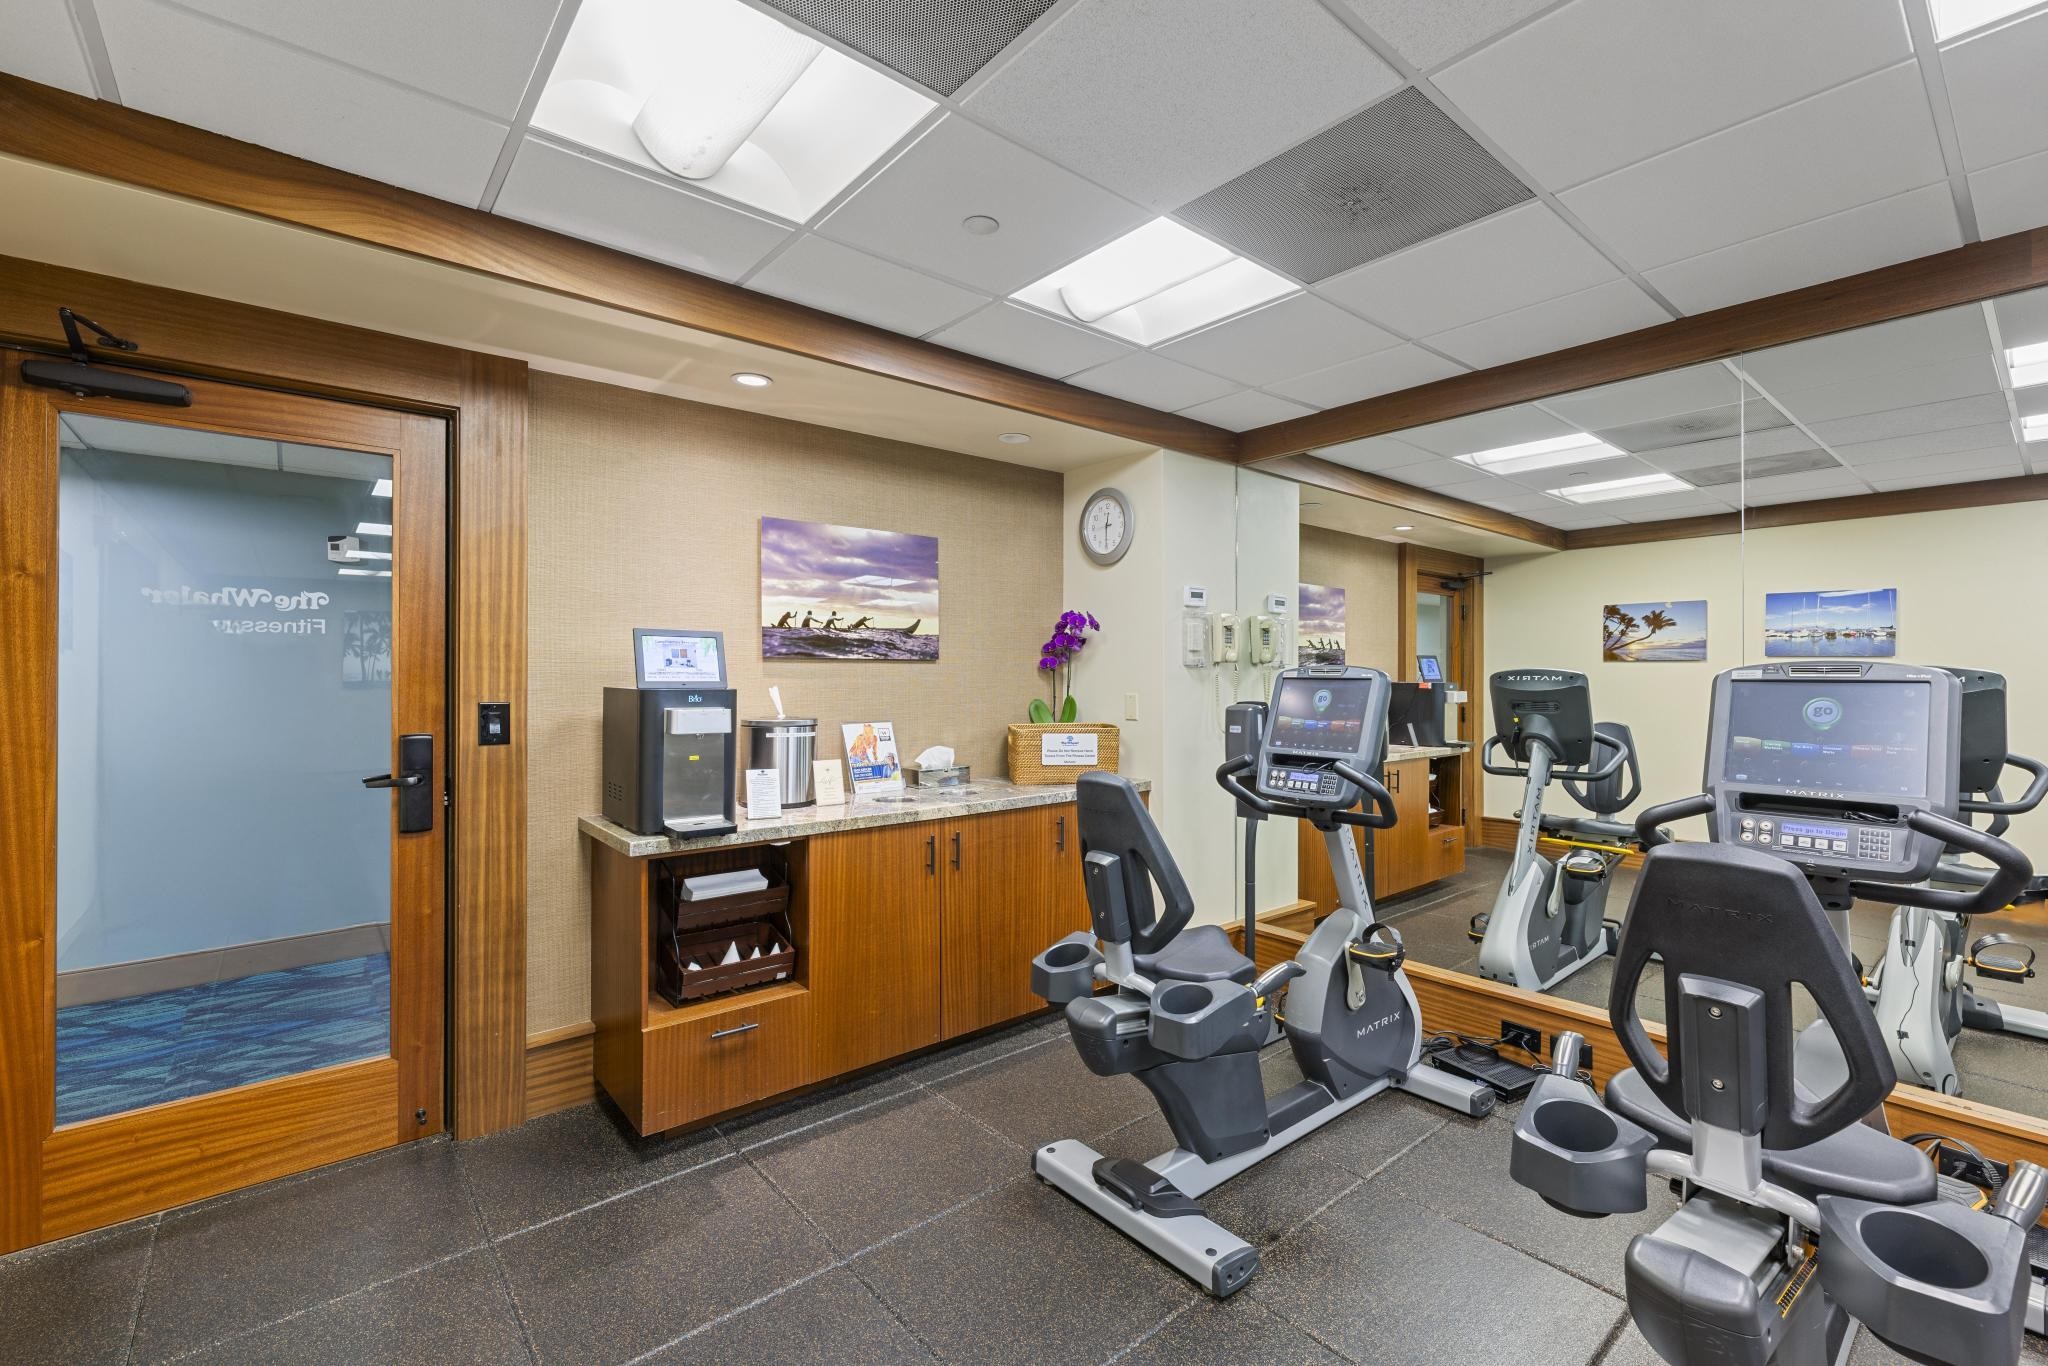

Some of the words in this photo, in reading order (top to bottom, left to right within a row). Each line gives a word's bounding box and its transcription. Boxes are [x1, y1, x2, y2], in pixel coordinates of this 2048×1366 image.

[1812, 704, 1834, 717] go
[1785, 789, 1845, 799] MATRIX
[1356, 1010, 1401, 1039] MATRIX
